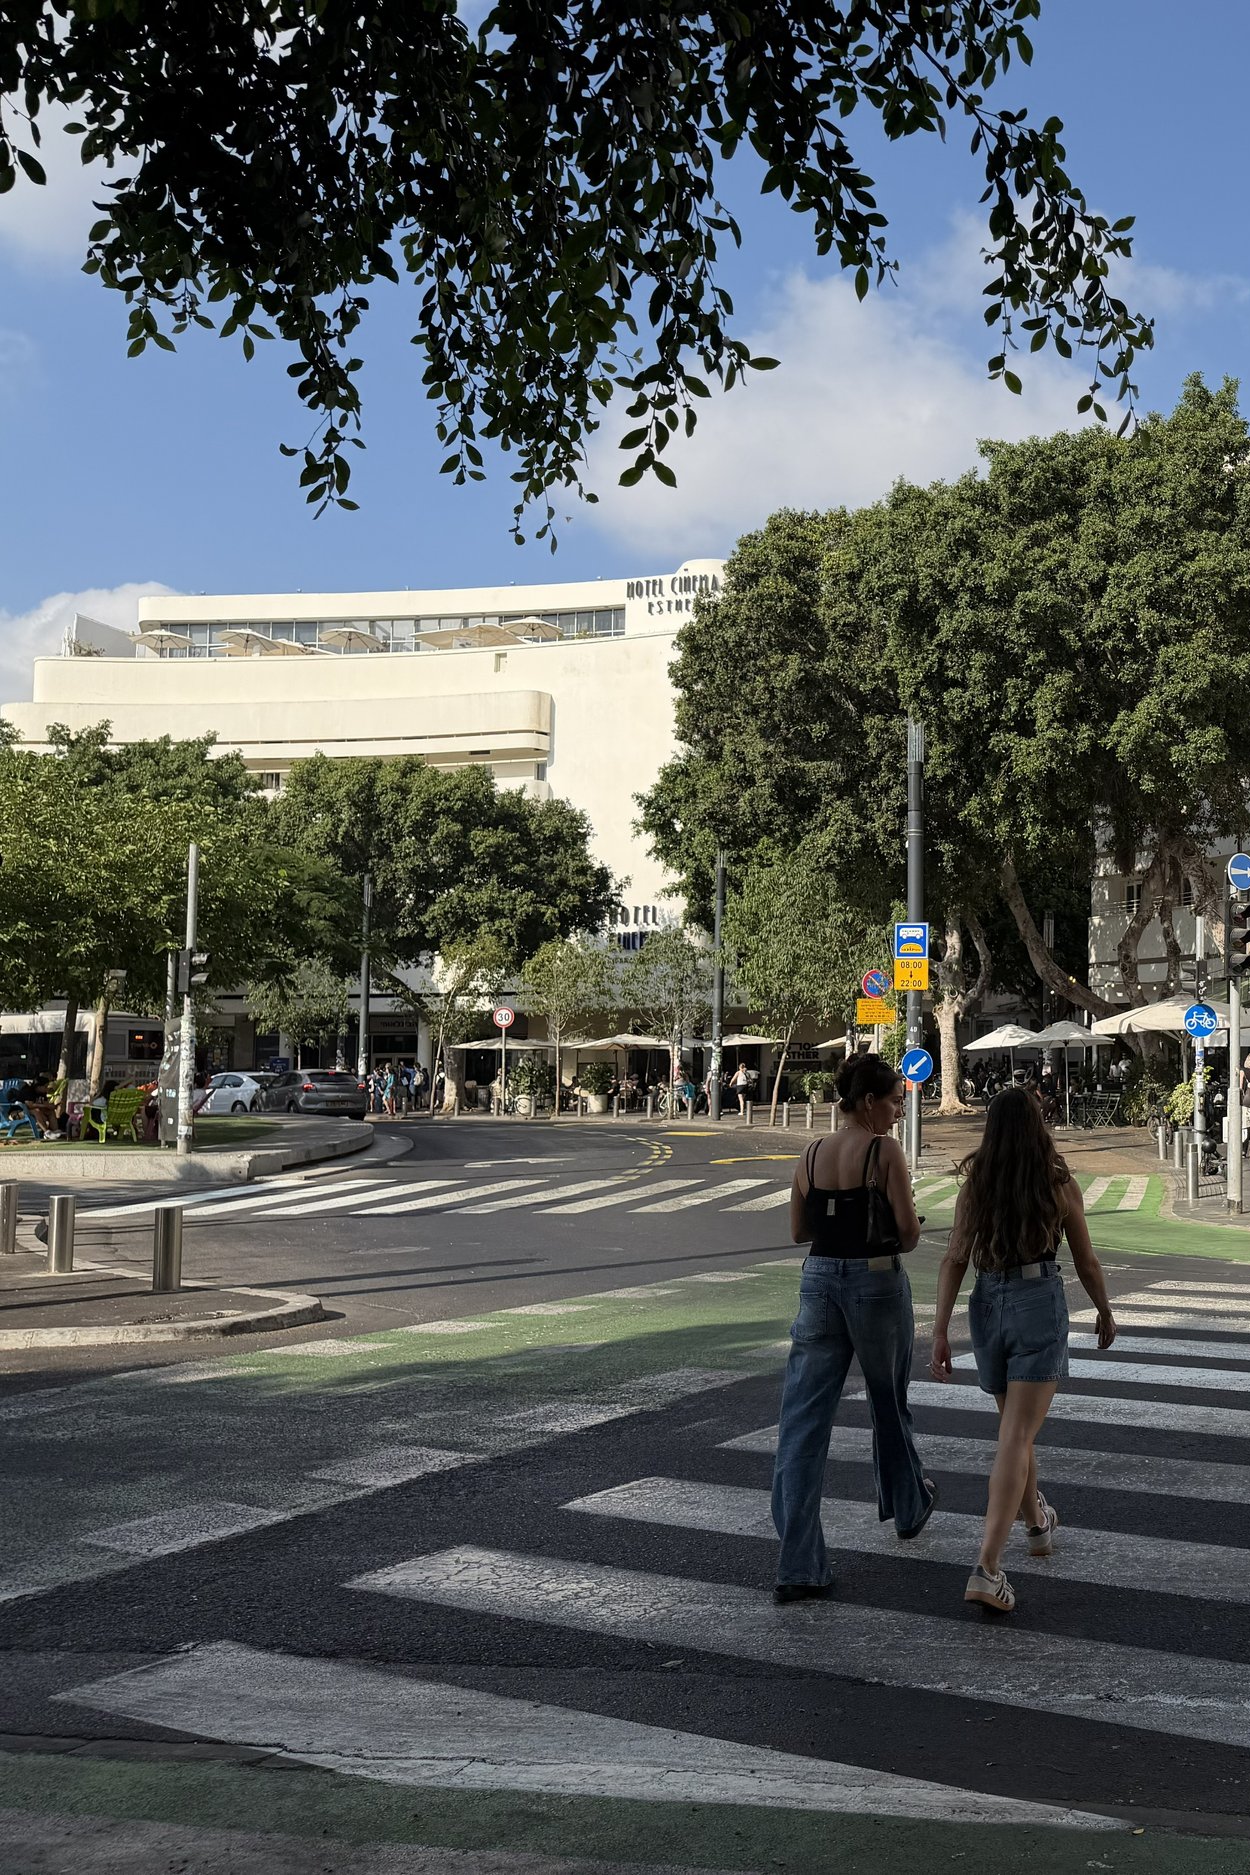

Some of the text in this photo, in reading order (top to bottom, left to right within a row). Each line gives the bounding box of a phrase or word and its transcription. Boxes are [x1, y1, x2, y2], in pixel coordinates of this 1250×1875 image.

[626, 578, 665, 600] HOTEL
[647, 598, 691, 616] ESTHE
[900, 961, 923, 969] 08:00
[900, 979, 923, 988] 22:00
[497, 1012, 511, 1022] 30
